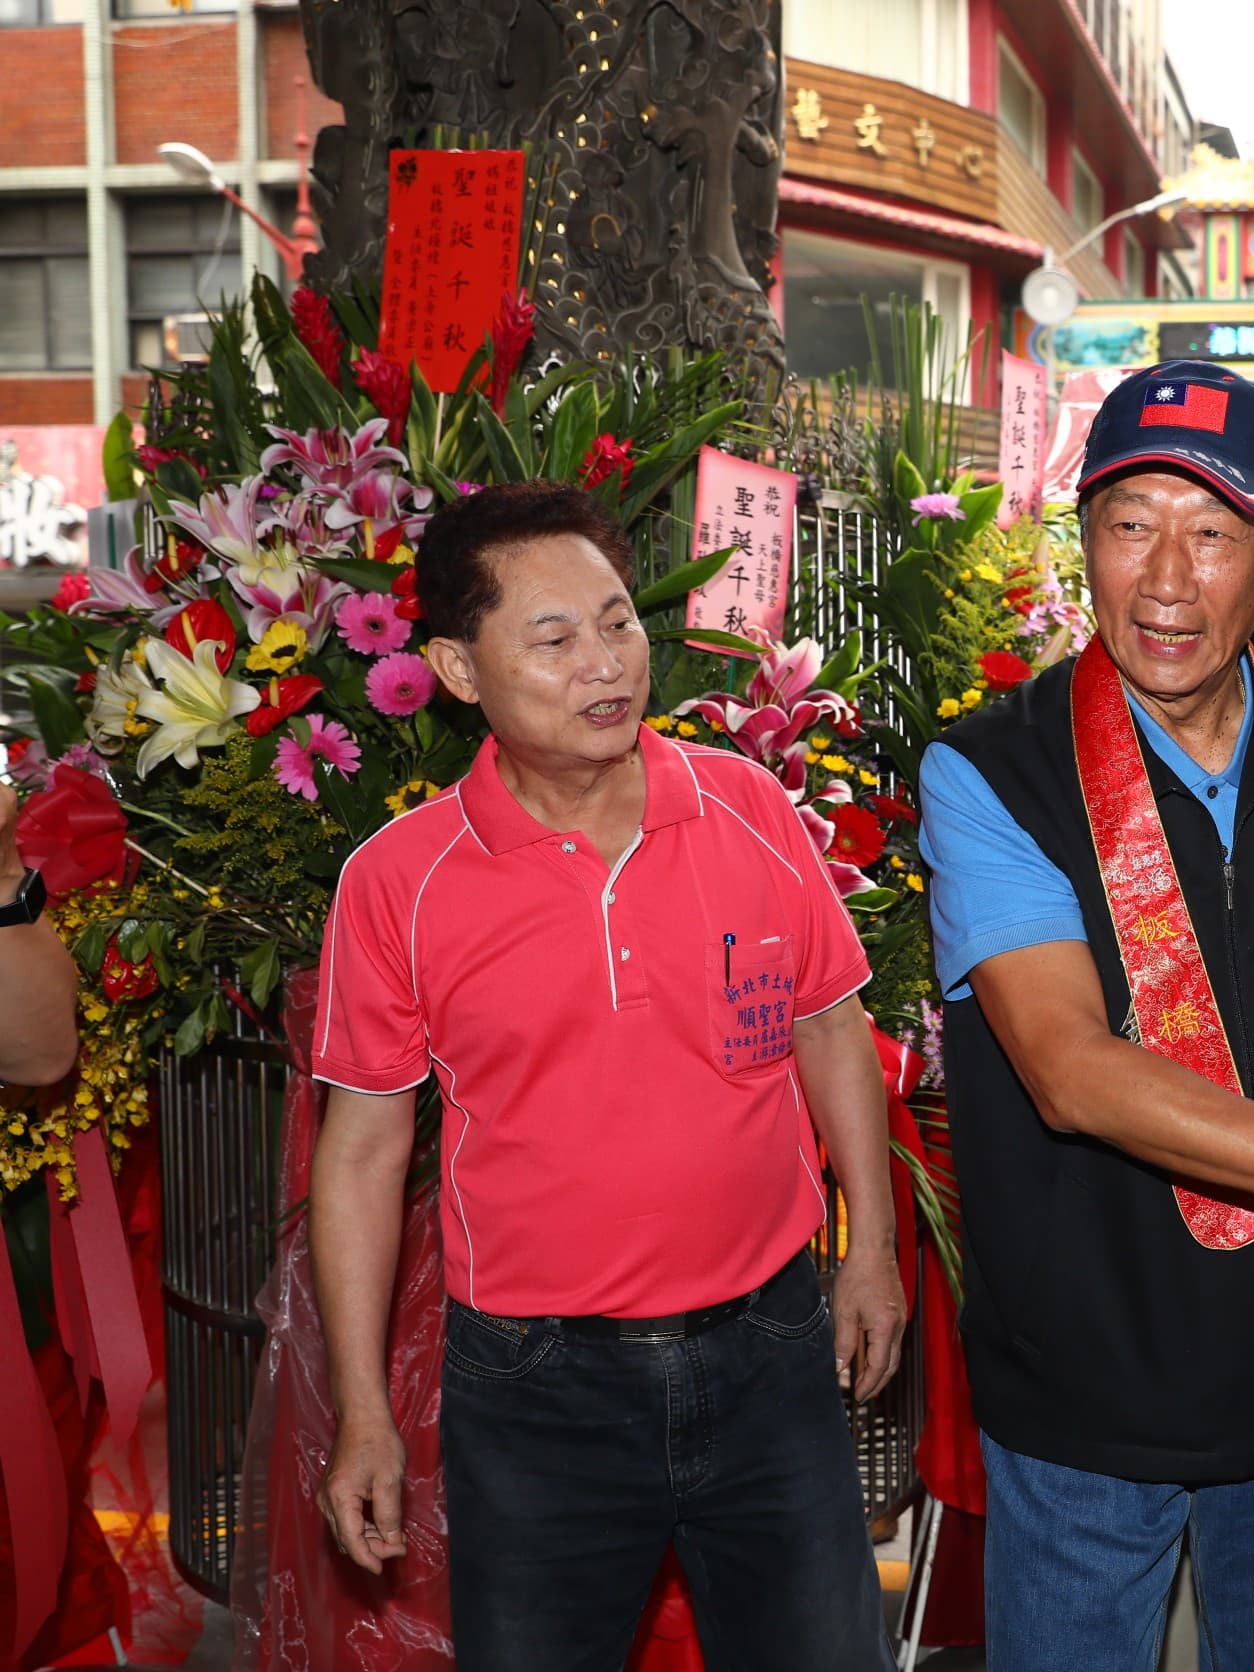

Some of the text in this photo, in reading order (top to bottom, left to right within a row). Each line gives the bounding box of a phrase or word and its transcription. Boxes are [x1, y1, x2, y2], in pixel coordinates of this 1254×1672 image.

[792, 88, 984, 179] 藝文中心
[443, 167, 476, 352] 聖誕千秋
[764, 485, 783, 518] 恭祝
[723, 487, 756, 637] 聖誕千秋
[737, 1000, 787, 1030] 順聖宮
